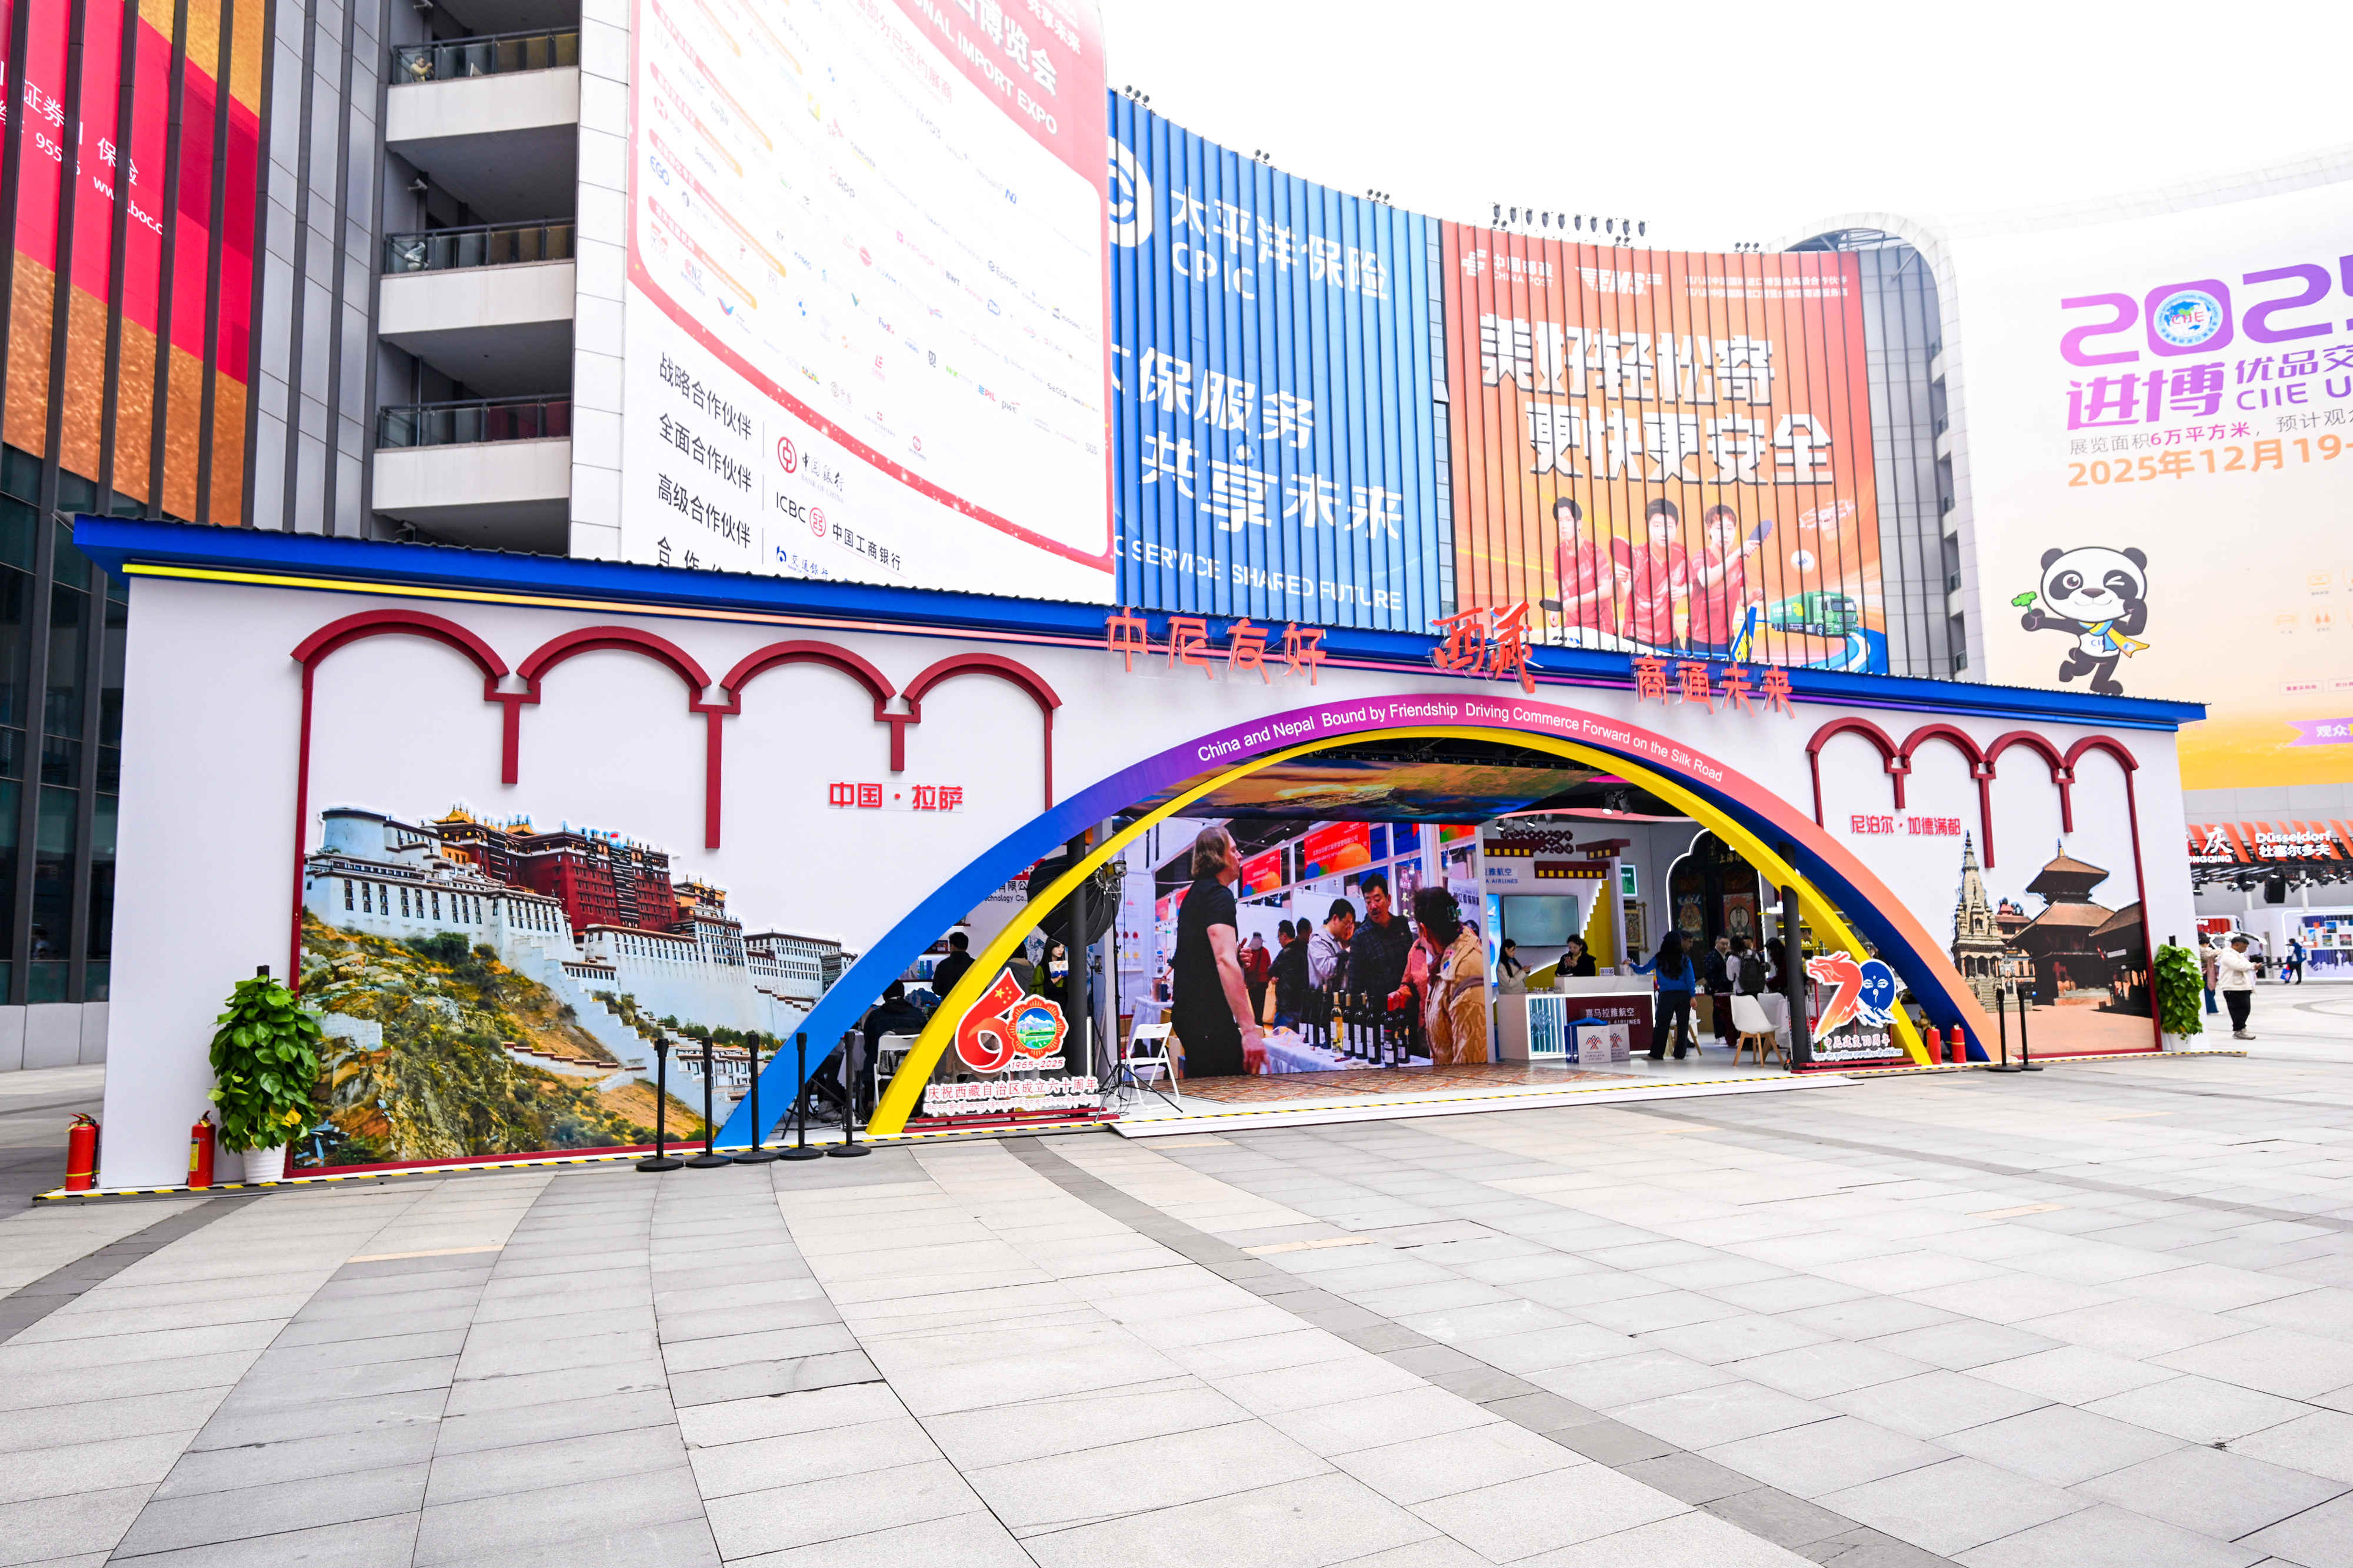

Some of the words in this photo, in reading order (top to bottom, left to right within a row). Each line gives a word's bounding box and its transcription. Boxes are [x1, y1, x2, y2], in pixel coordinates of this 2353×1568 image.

[958, 31, 1015, 98] IMPORT
[1018, 87, 1058, 135] EXPO
[1171, 185, 1388, 301] 太平洋保险
[1171, 242, 1255, 300] CPIC
[1494, 253, 1553, 278] 中国邮政
[1494, 271, 1524, 283] CHINA
[1529, 275, 1553, 288] POST
[1595, 269, 1646, 295] EMS
[878, 316, 895, 335] FedEx
[2060, 254, 2353, 367] 202
[2172, 311, 2204, 325] CIIE
[1479, 313, 1775, 407] 美好轻松寄
[659, 352, 752, 441] 战略合作伙伴
[2066, 361, 2225, 431] 进博
[2237, 382, 2308, 411] CIIE
[659, 412, 752, 493] 全面合作伙伴
[1525, 401, 1833, 486] 更快更安全
[658, 472, 751, 549] 高级合作伙伴
[776, 492, 806, 523] ICBC
[1138, 431, 1402, 541] 共享未来
[833, 523, 901, 571] 中国工商银行
[1132, 539, 1221, 581] SERVICE
[1232, 564, 1314, 598] SHARED
[1320, 582, 1402, 610] FUTURE
[1105, 606, 1327, 686] 中尼友好
[1428, 601, 1537, 695] 西藏
[1634, 654, 1795, 719] 商通未来
[1197, 738, 1241, 762] China
[1244, 727, 1271, 746] and
[1272, 716, 1315, 739] Nepal
[1322, 708, 1367, 728] Bound
[1369, 706, 1386, 723] by
[1389, 702, 1458, 719] Friendship
[1465, 702, 1509, 722] Driving
[1513, 707, 1579, 730] Commerce
[1582, 720, 1631, 745] Forward
[1633, 736, 1648, 750] on
[1650, 740, 1668, 758] the
[1671, 748, 1691, 768] Silk
[1694, 759, 1723, 783] Road
[2316, 723, 2353, 738] 观众
[2255, 830, 2332, 844] Düsseldorf
[2258, 843, 2331, 858] 杜塞尔多夫
[1585, 1007, 1635, 1017] 喜马拉雅航空
[927, 1078, 1098, 1100] 庆祝西藏自治区成立六十周年
